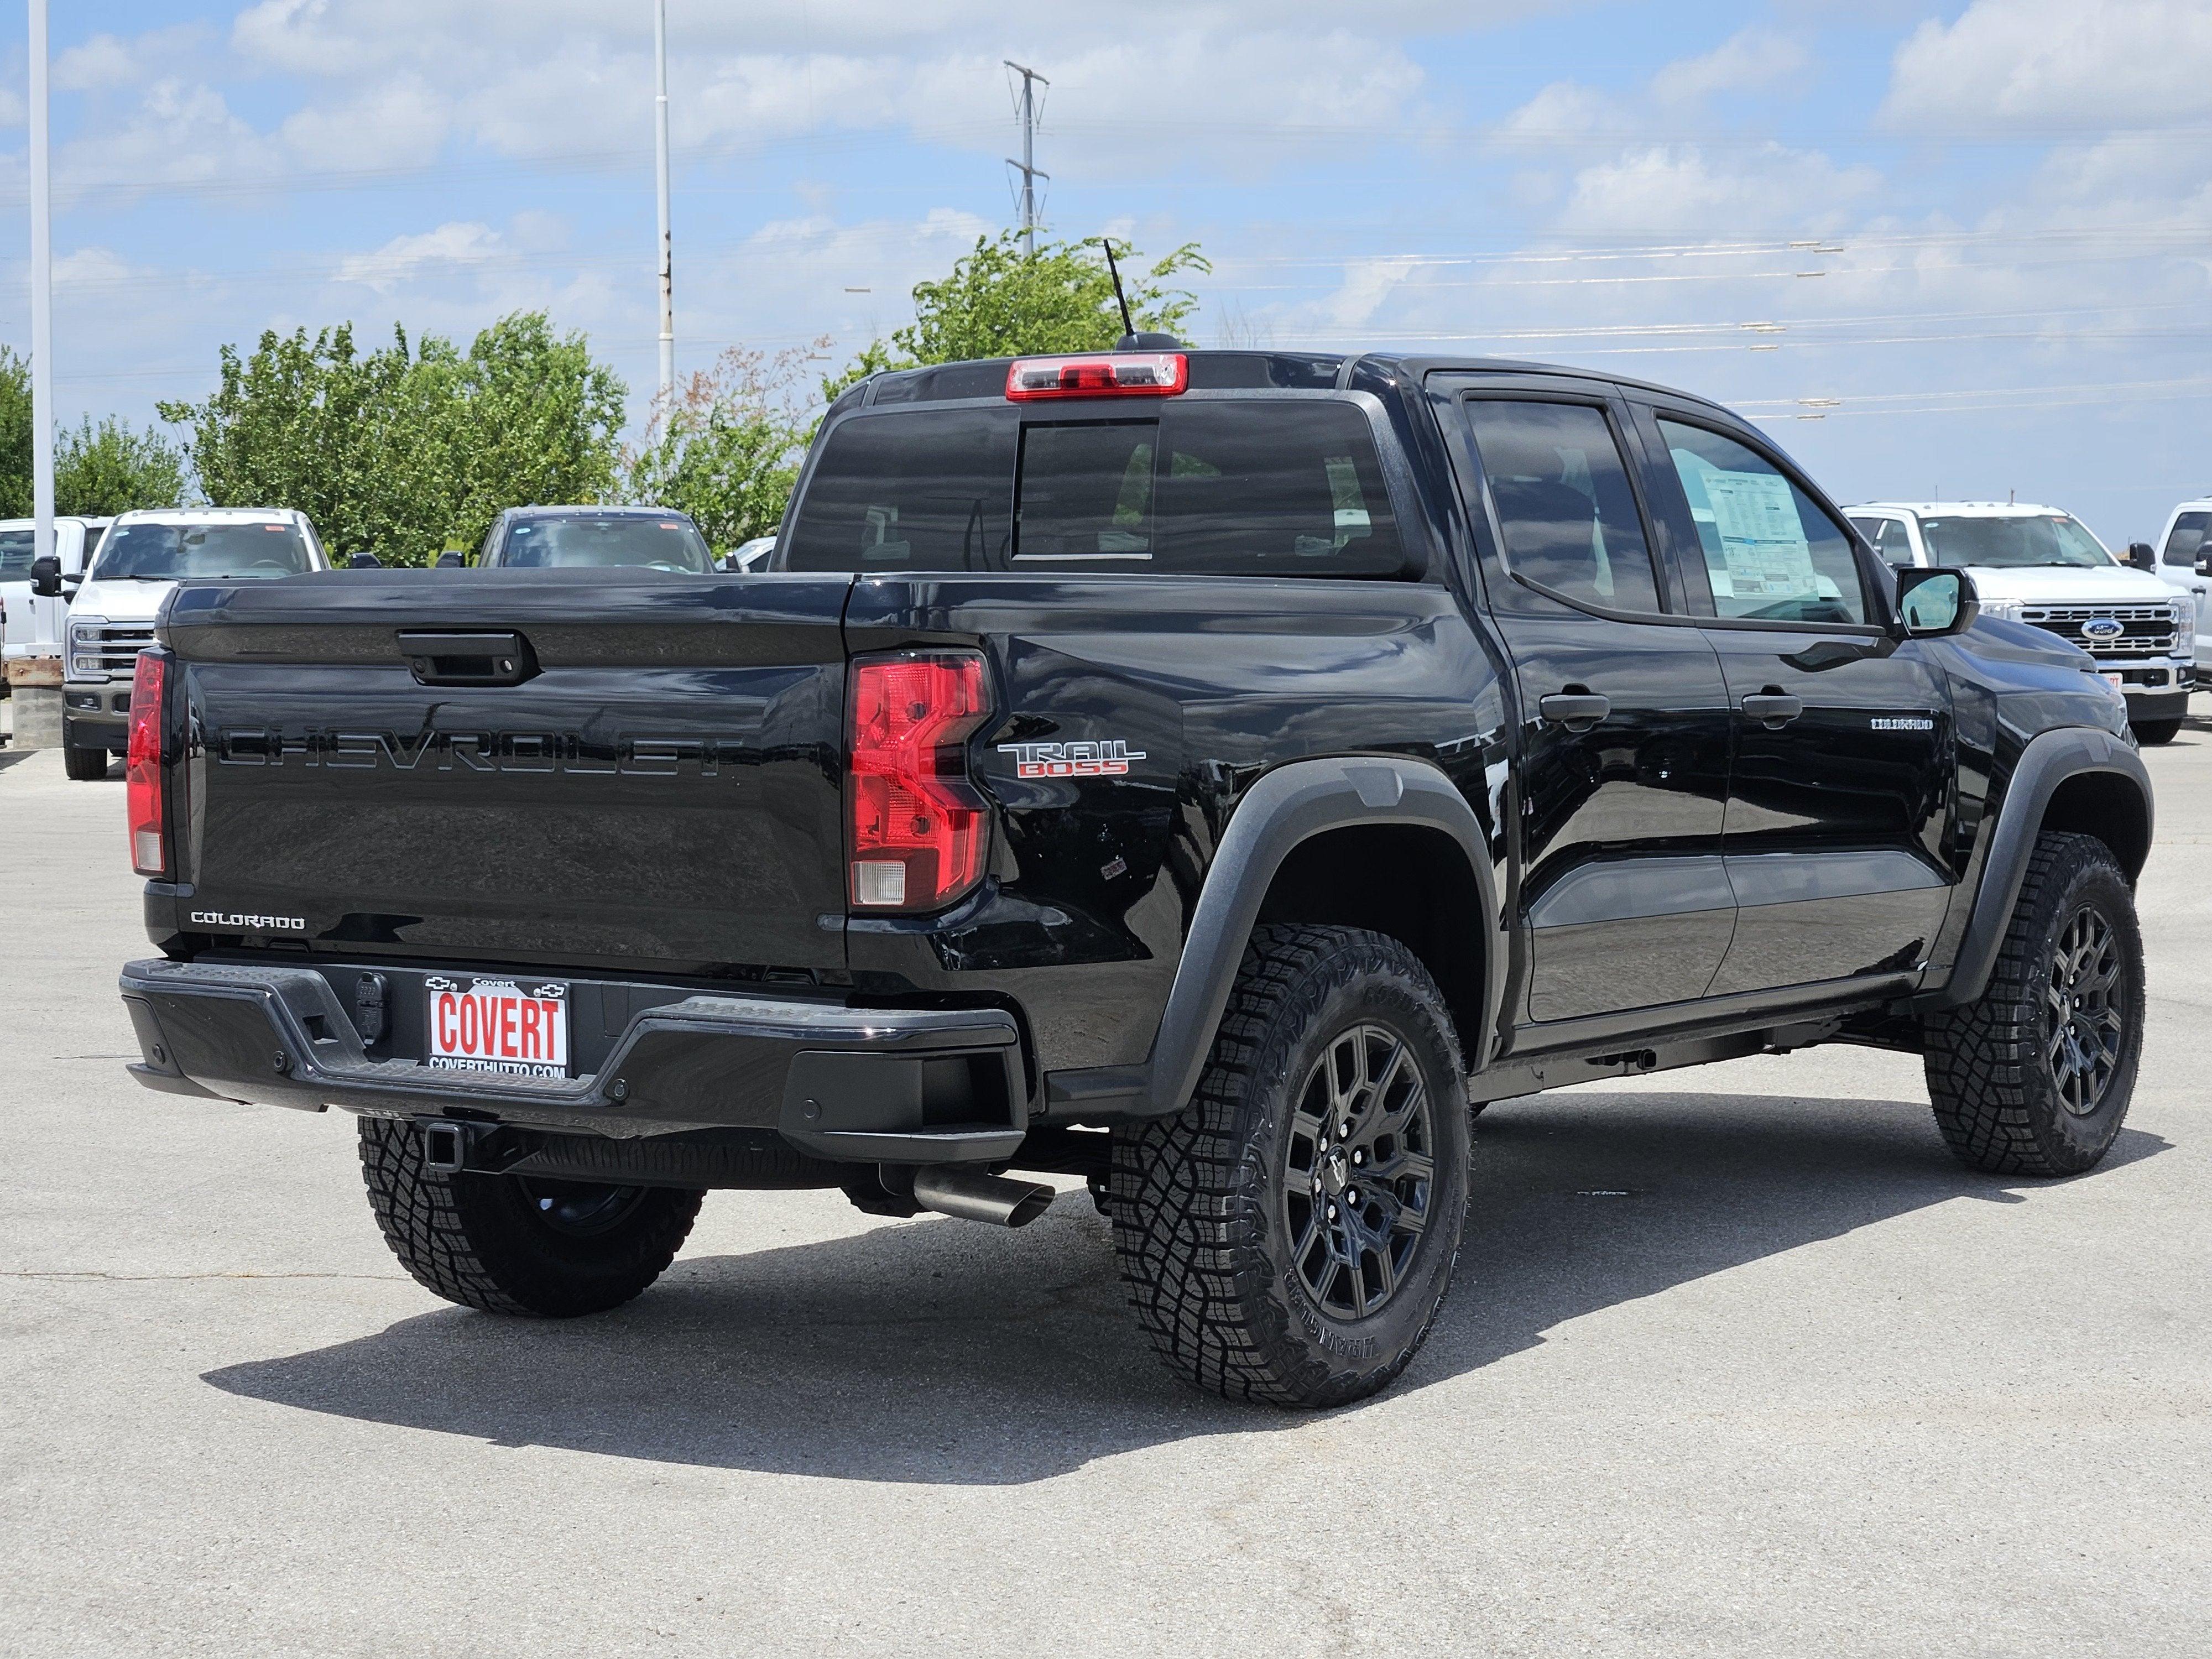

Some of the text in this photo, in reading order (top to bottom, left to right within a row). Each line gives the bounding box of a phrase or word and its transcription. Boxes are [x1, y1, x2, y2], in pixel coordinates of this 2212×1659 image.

[2094, 624, 2114, 634] Ford
[1870, 718, 1934, 730] COLORADO
[219, 725, 743, 776] CHEVROLET
[997, 740, 1146, 762] TRAIL
[1018, 759, 1129, 778] BOSS
[191, 911, 305, 930] COLORADO
[472, 978, 517, 988] Covert
[439, 992, 559, 1061] COVERT
[429, 1056, 565, 1079] COVERTHUTTOCOM
